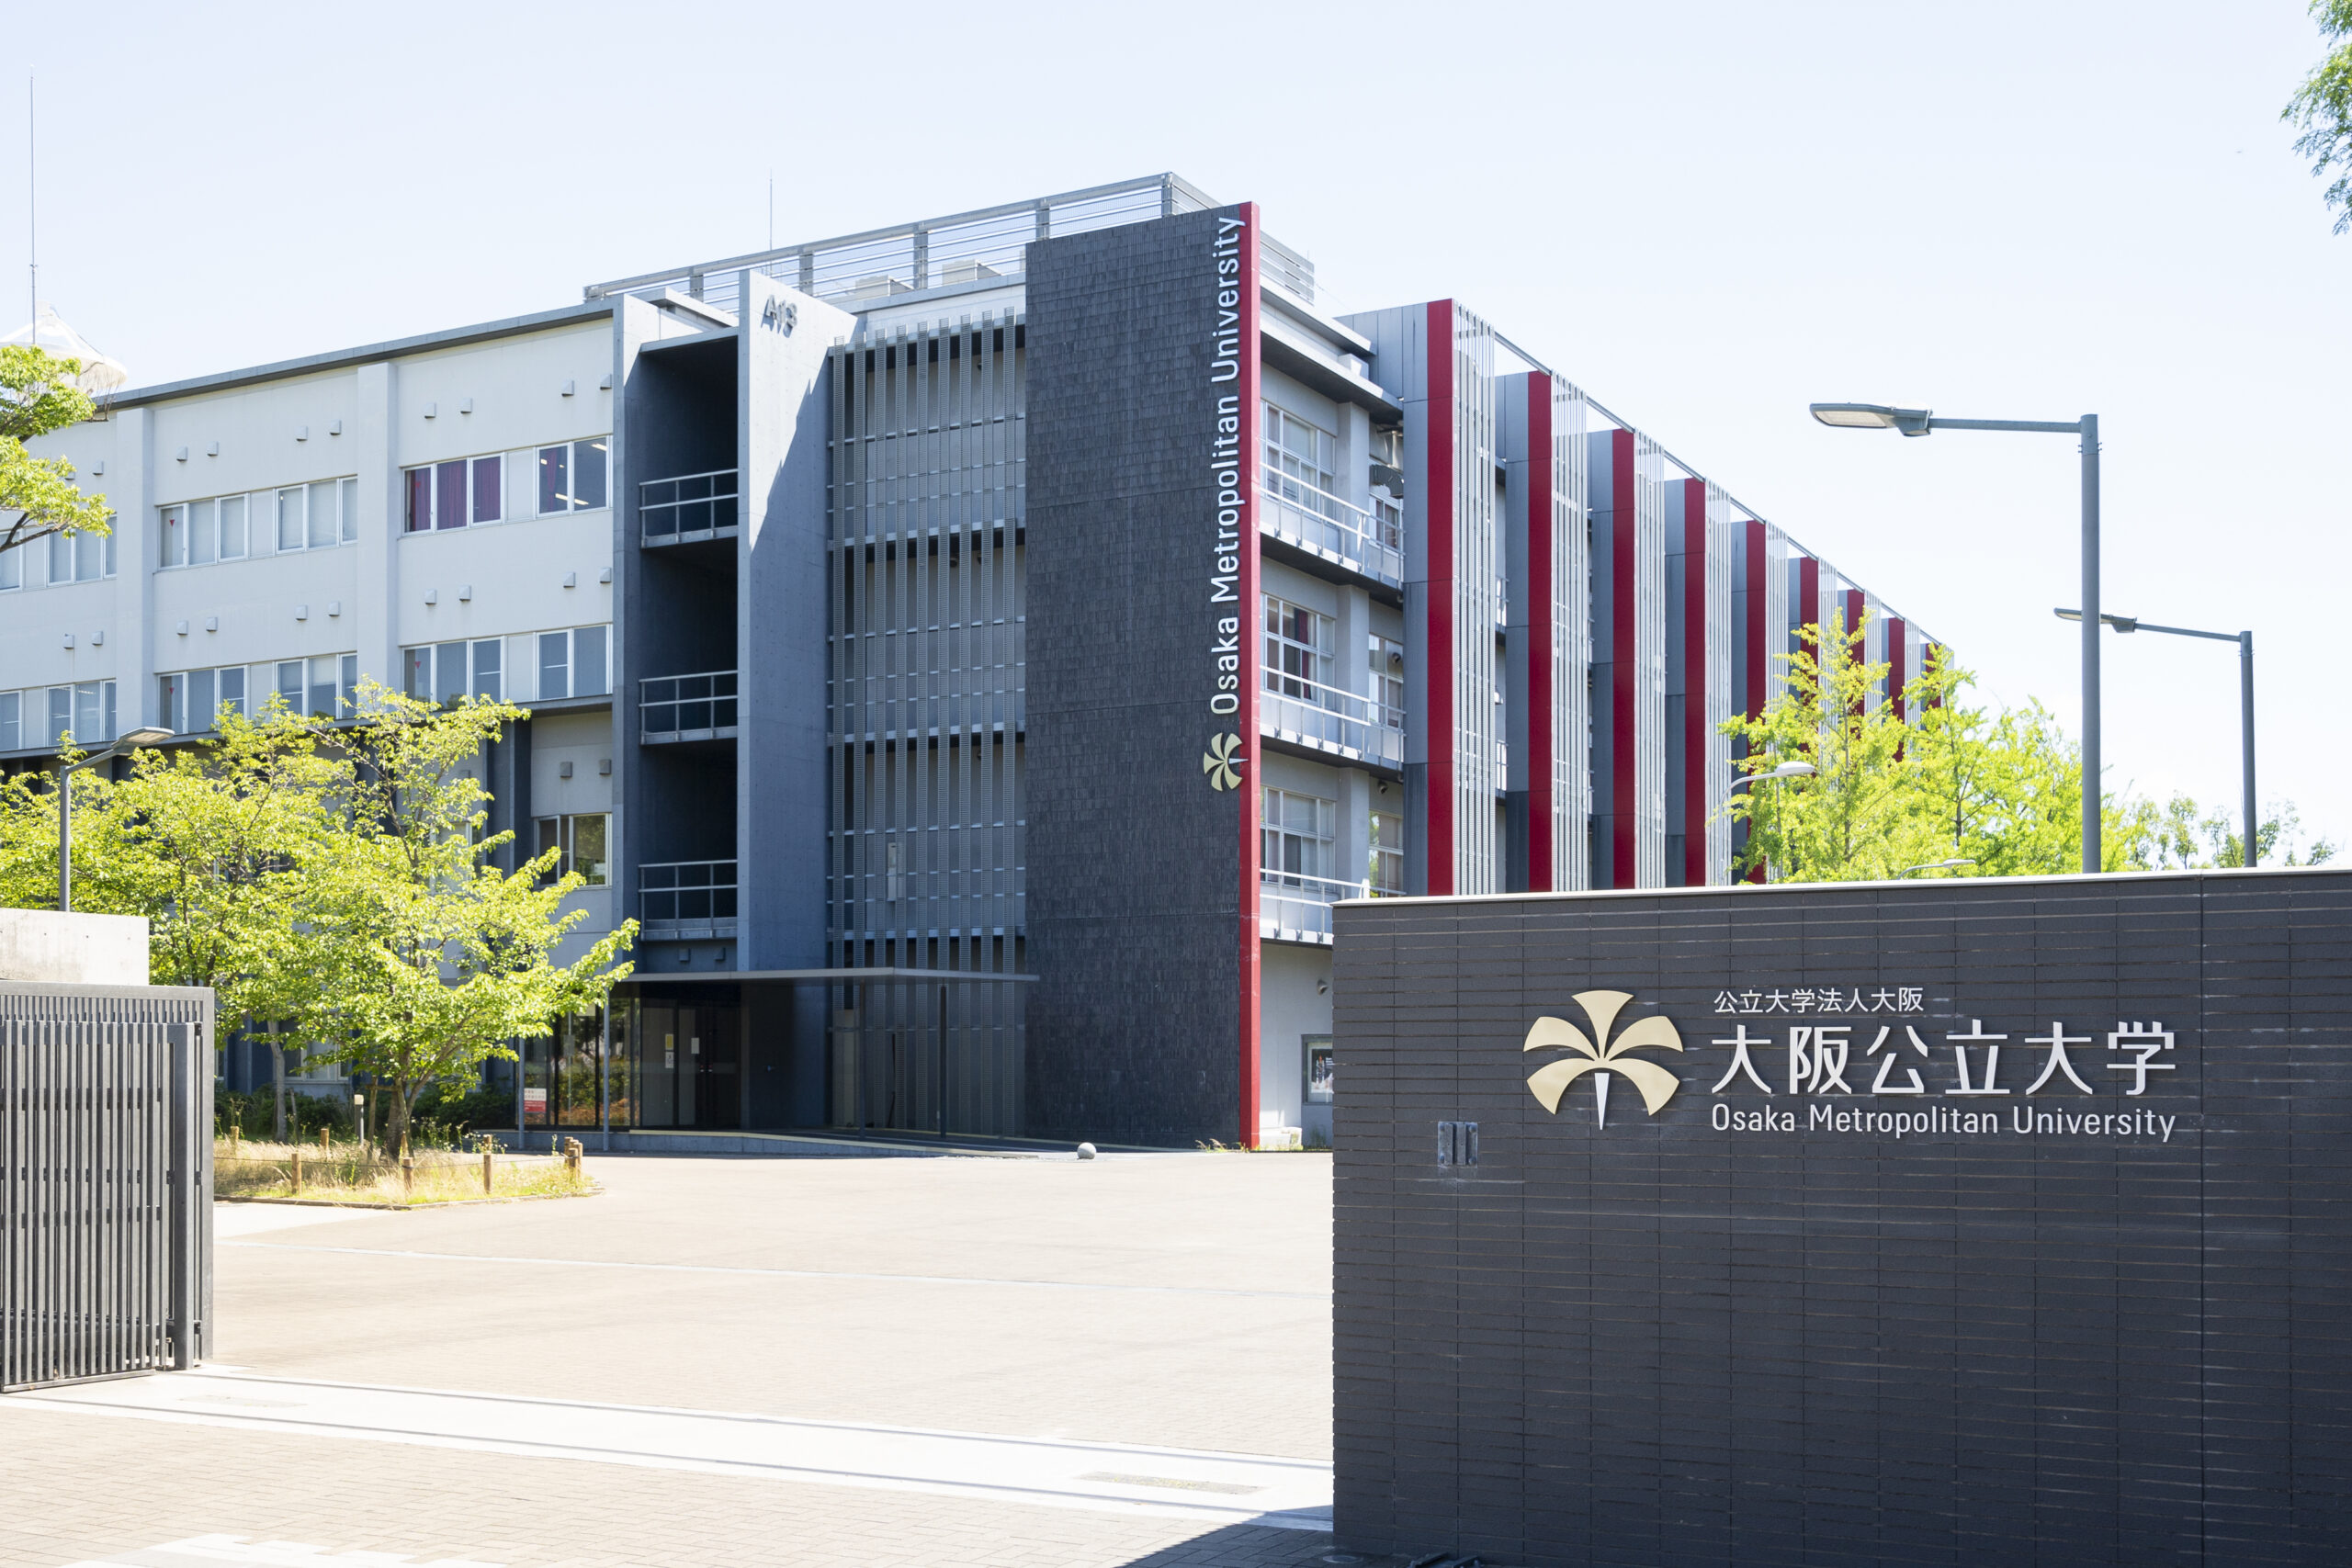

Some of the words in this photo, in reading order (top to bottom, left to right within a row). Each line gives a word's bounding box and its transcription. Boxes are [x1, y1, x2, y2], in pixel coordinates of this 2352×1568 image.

[1211, 217, 1246, 382] University
[1211, 396, 1246, 603] Metropolitan
[1210, 616, 1239, 715] Osaka
[1713, 987, 1924, 1013] 公立大学法人大阪
[1712, 1019, 2176, 1095] 大阪公立大学
[1712, 1103, 1795, 1133] Osaka
[1810, 1104, 1998, 1138] Metropolitan
[2014, 1106, 2175, 1142] University
